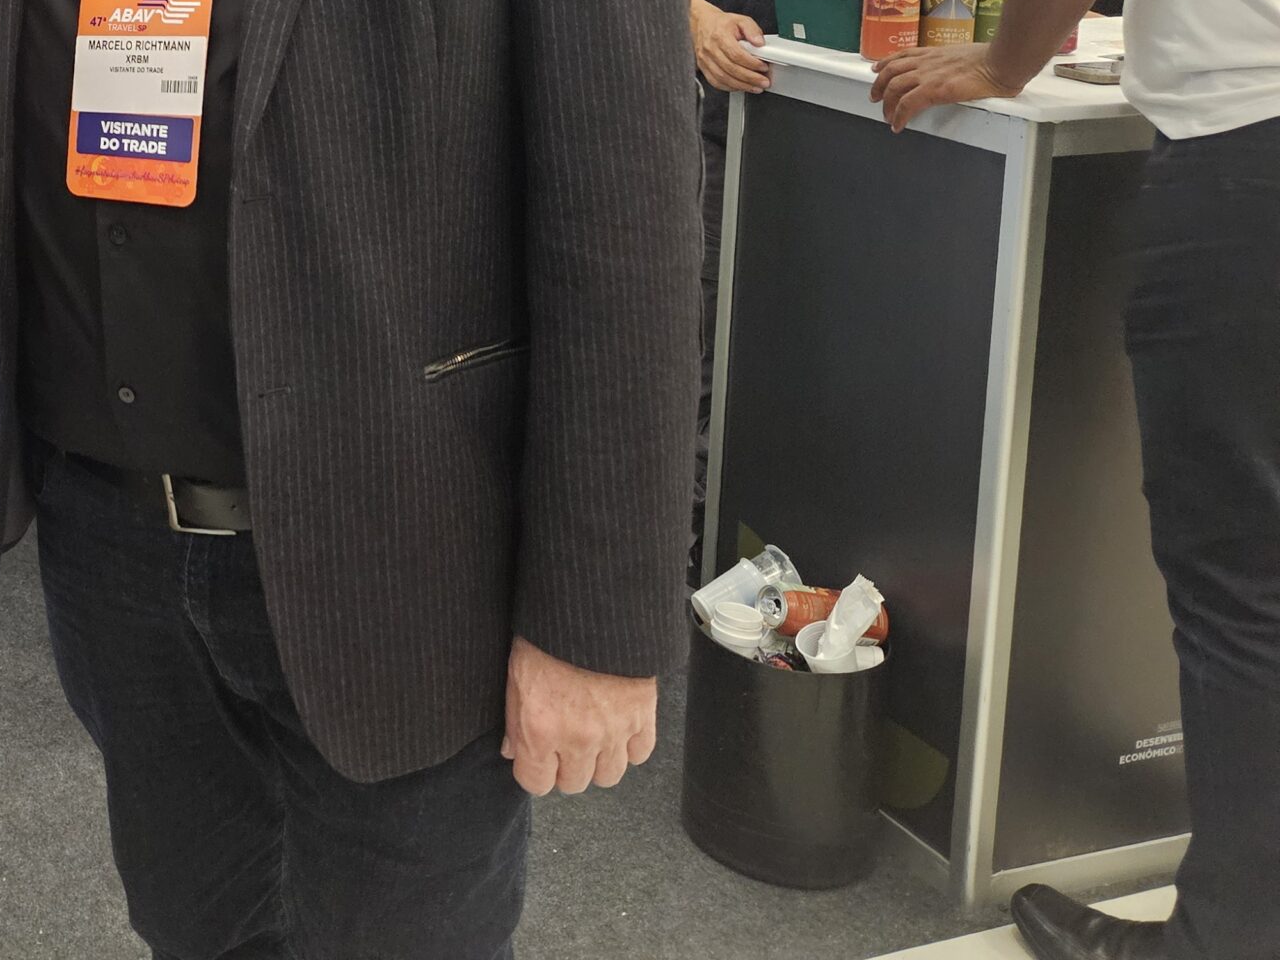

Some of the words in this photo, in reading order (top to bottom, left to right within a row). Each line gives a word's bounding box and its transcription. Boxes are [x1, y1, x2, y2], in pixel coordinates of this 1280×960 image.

[108, 7, 155, 23] ABAV
[88, 40, 133, 51] MARCELO
[135, 40, 191, 51] RICHTMANN
[125, 55, 149, 64] XRBM
[109, 66, 135, 74] VISITANTE
[101, 120, 169, 138] VISITANTE
[100, 137, 120, 151] DO
[122, 139, 168, 155] TRADE
[1119, 746, 1176, 765] ECONÔMICO
